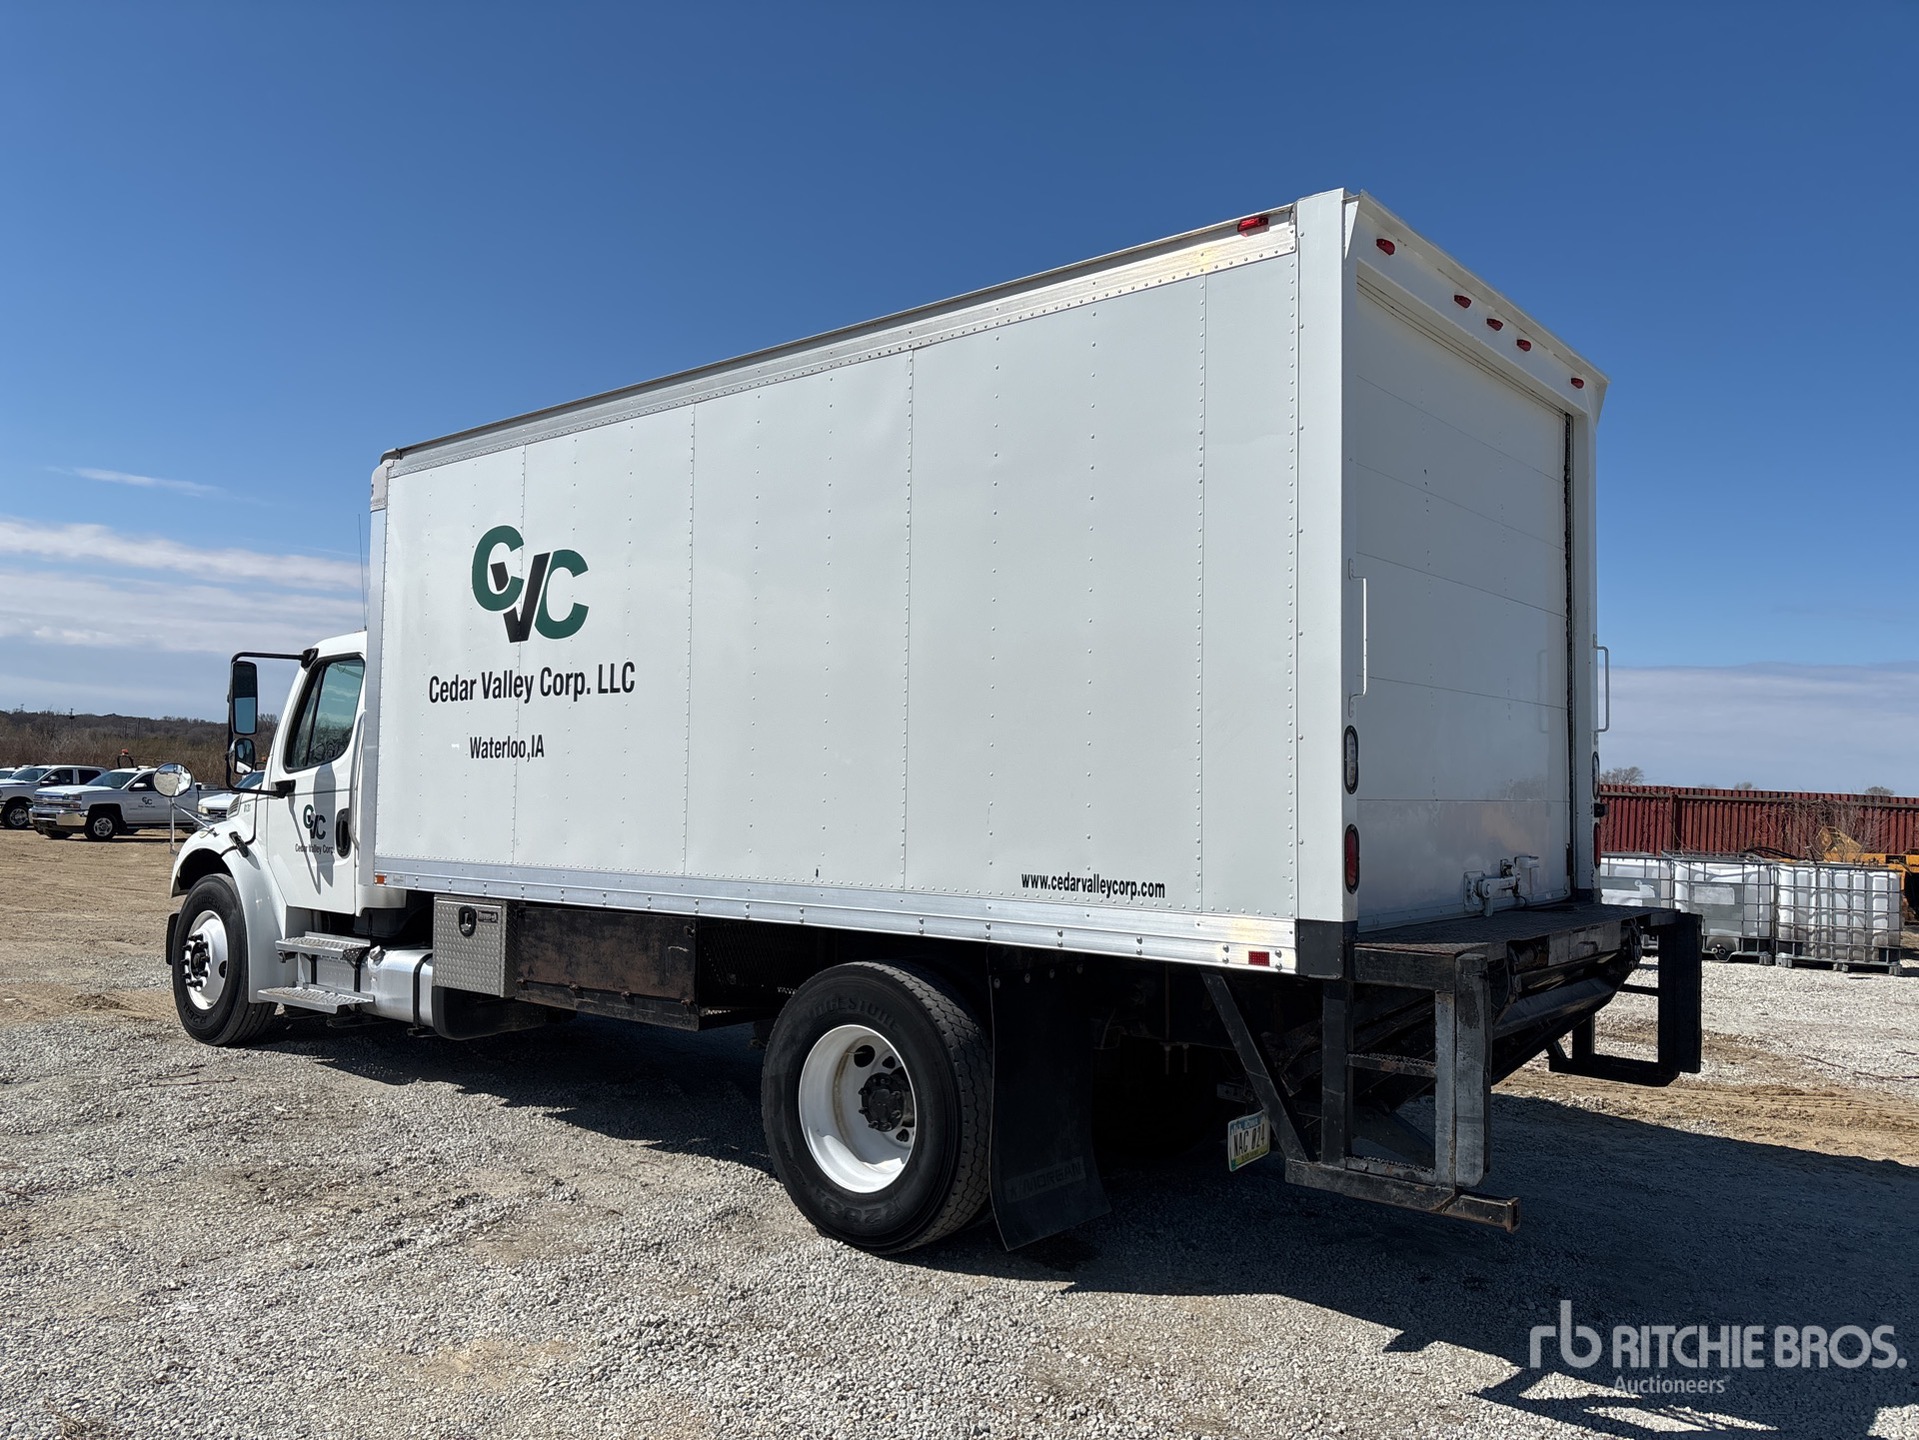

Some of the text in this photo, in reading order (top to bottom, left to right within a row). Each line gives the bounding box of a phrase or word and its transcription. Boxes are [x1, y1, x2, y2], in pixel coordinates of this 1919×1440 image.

[471, 525, 589, 643] CVC
[429, 661, 635, 704] Cedar Valley Corp. LLC
[470, 734, 544, 762] Waterloo,IA
[303, 804, 326, 840] CVC
[1021, 872, 1165, 900] www.cedarvalleycorp.com
